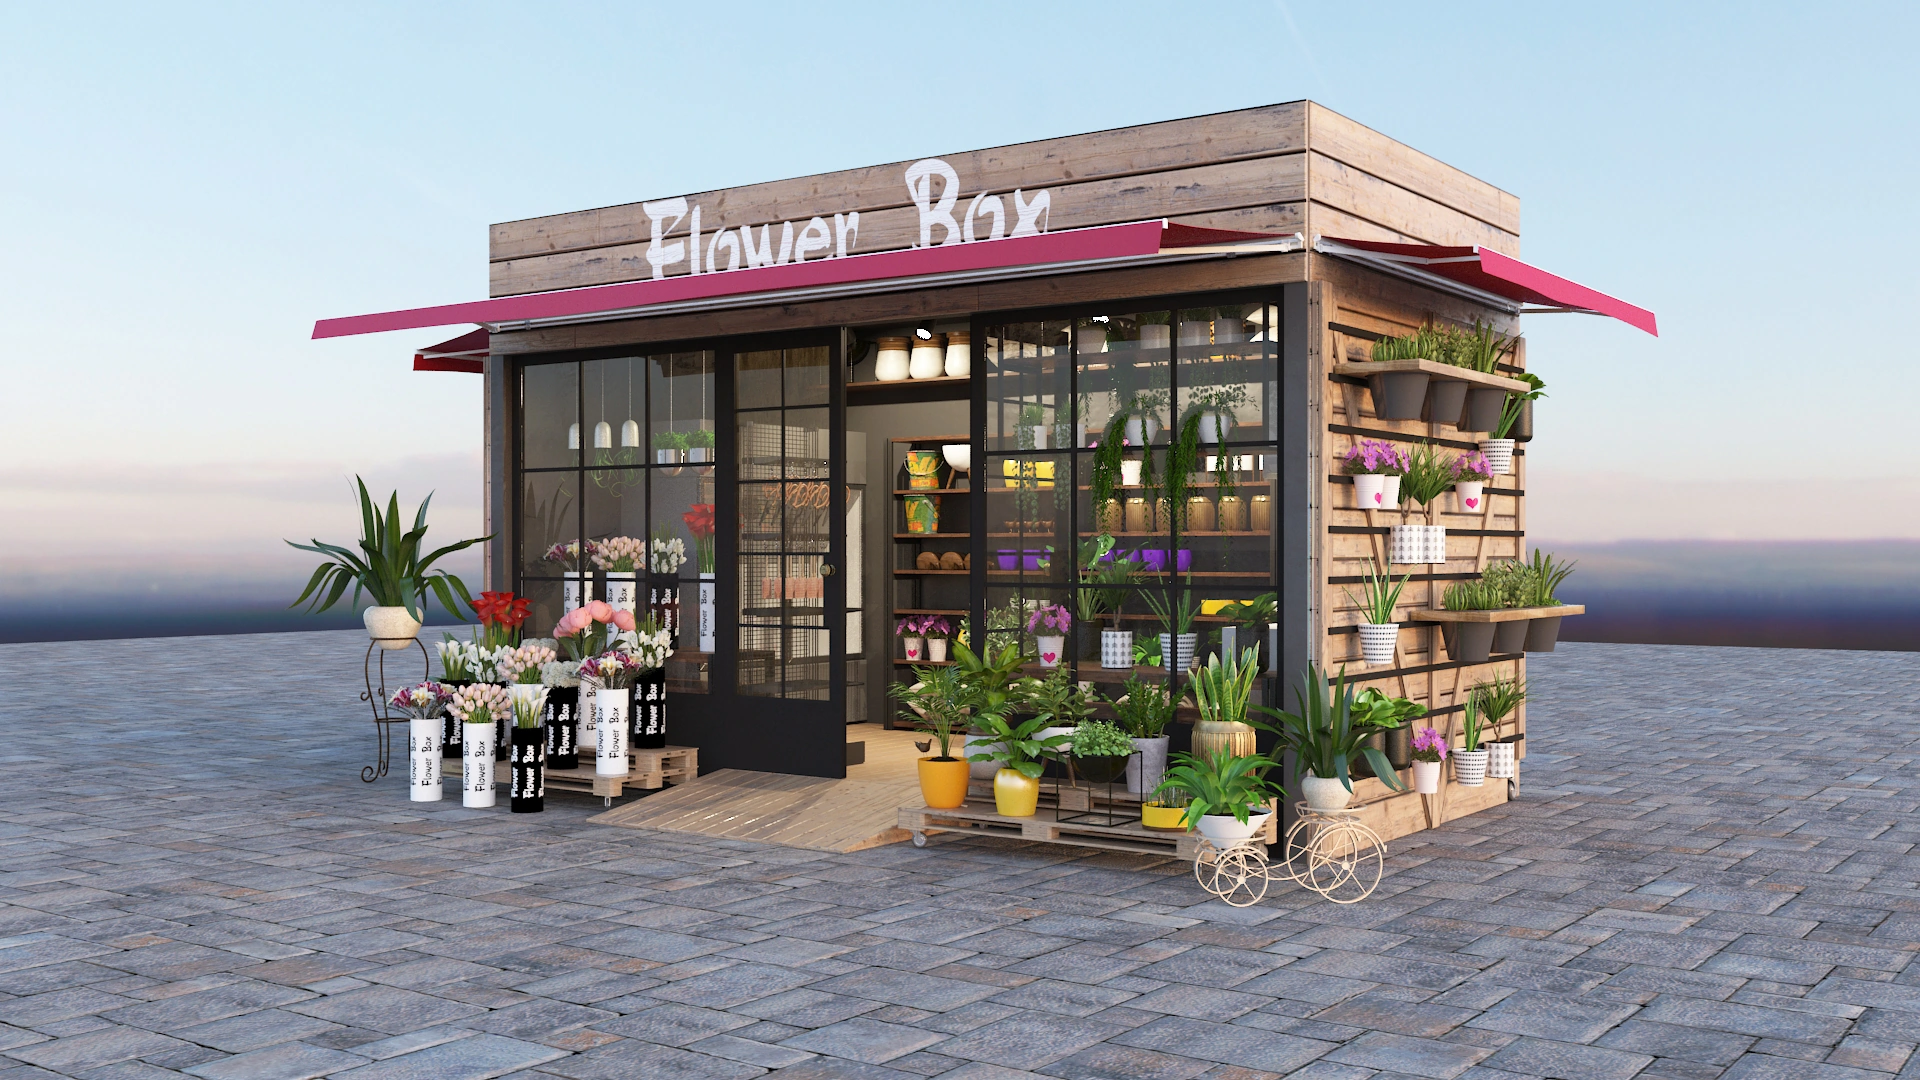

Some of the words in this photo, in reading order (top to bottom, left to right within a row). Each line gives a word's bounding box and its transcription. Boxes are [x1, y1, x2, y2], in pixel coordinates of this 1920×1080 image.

[643, 197, 859, 280] Flower
[905, 158, 1050, 250] Box
[618, 588, 627, 603] Box
[661, 588, 672, 605] Box
[646, 684, 657, 701] Box
[558, 703, 570, 721] Box
[609, 707, 619, 724] Box
[646, 705, 657, 735] Flower
[422, 736, 432, 752] Box
[475, 741, 485, 757] Box
[558, 725, 570, 756] Flower
[609, 729, 619, 759] Flower
[523, 745, 534, 763] Box
[422, 758, 432, 786] Flower
[475, 763, 485, 792] Flower
[523, 767, 534, 799] Flower
